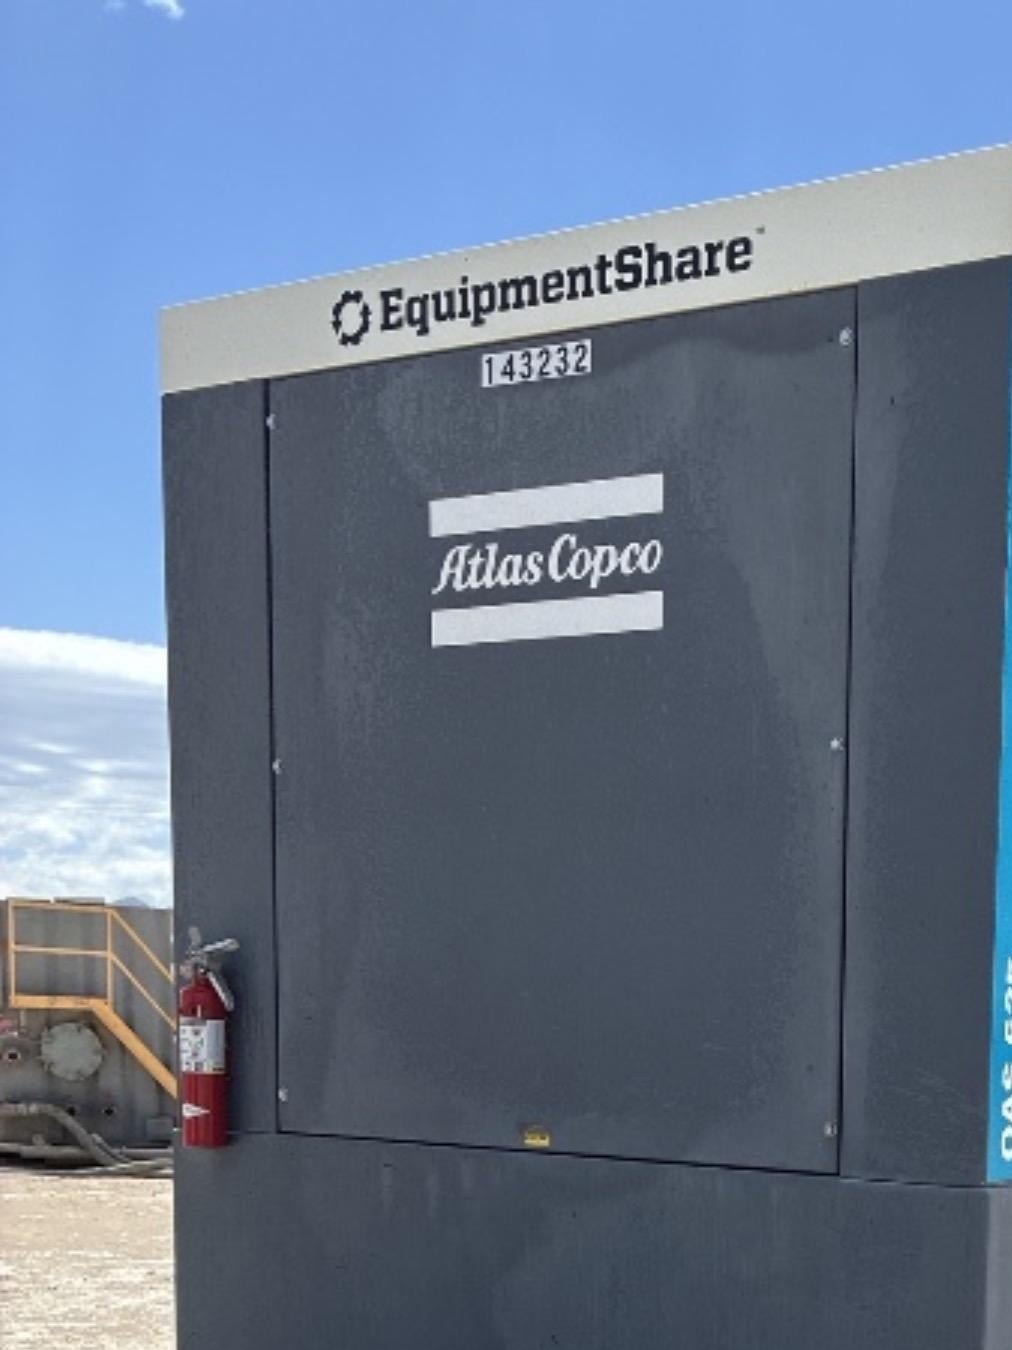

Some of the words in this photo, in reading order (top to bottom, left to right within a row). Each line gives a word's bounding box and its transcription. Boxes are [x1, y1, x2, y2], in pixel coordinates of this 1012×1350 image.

[380, 235, 753, 335] EquipmentShare
[484, 343, 588, 386] 143232
[431, 541, 543, 594] Atlas
[548, 533, 662, 586] Copco
